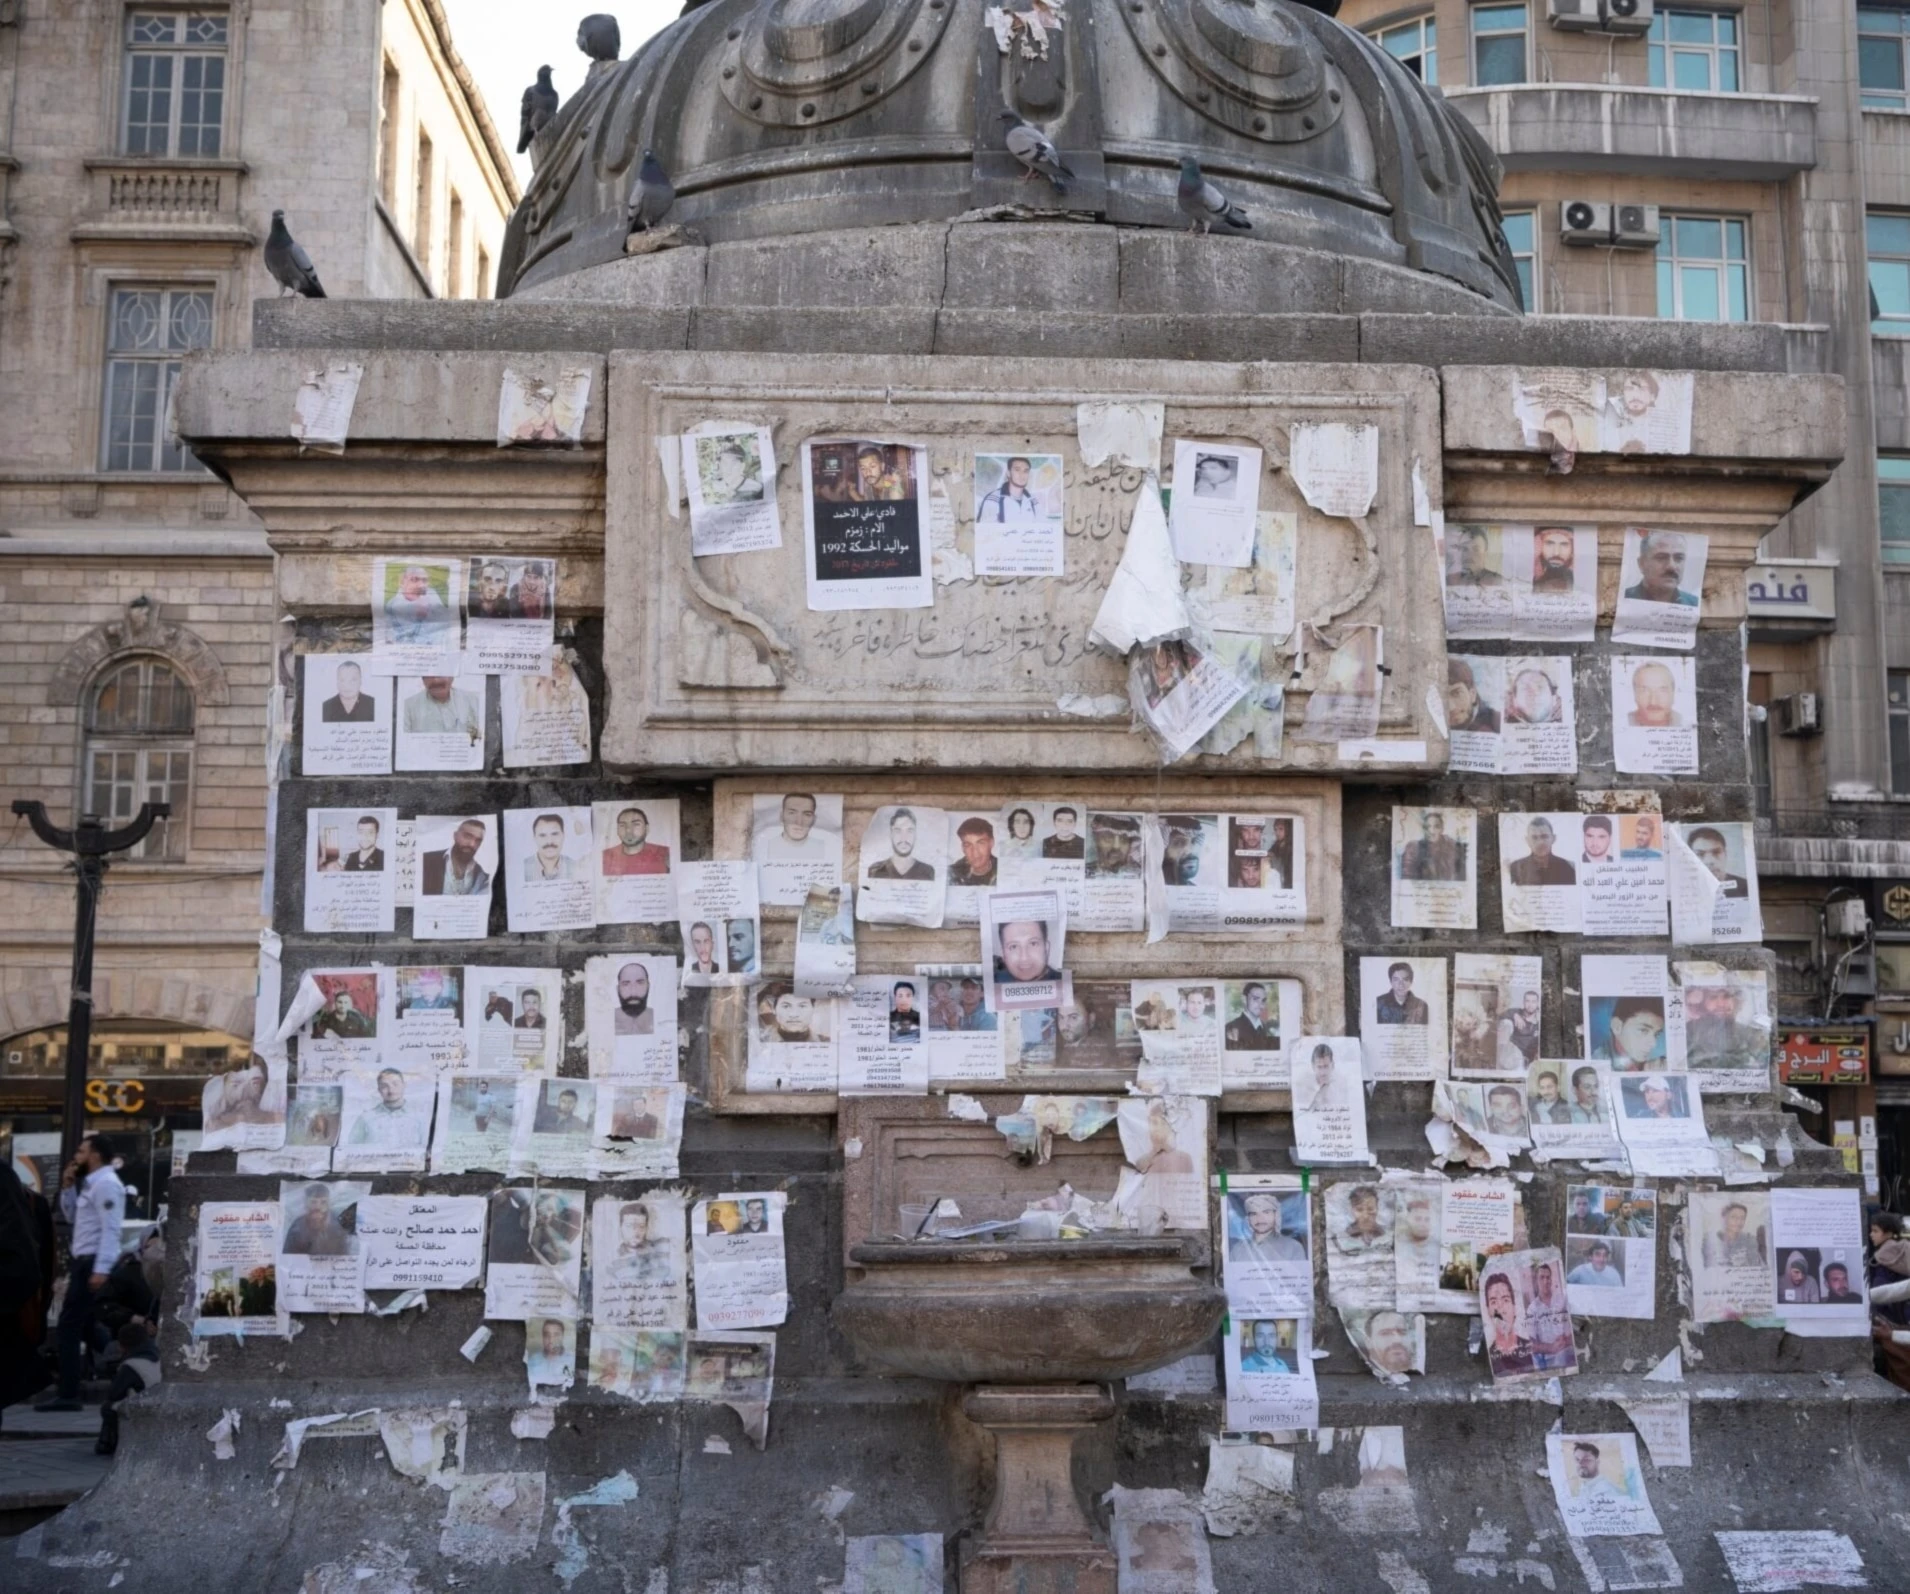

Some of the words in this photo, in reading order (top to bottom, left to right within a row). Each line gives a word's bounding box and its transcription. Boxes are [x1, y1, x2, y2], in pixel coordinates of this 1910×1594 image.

[1790, 1049, 1830, 1069] البرج
[1451, 1189, 1477, 1200] مفقود
[1480, 1190, 1506, 1201] الشاب
[408, 1204, 437, 1215] المعتقل
[212, 1213, 240, 1224] مفقود
[242, 1212, 270, 1224] الشاب
